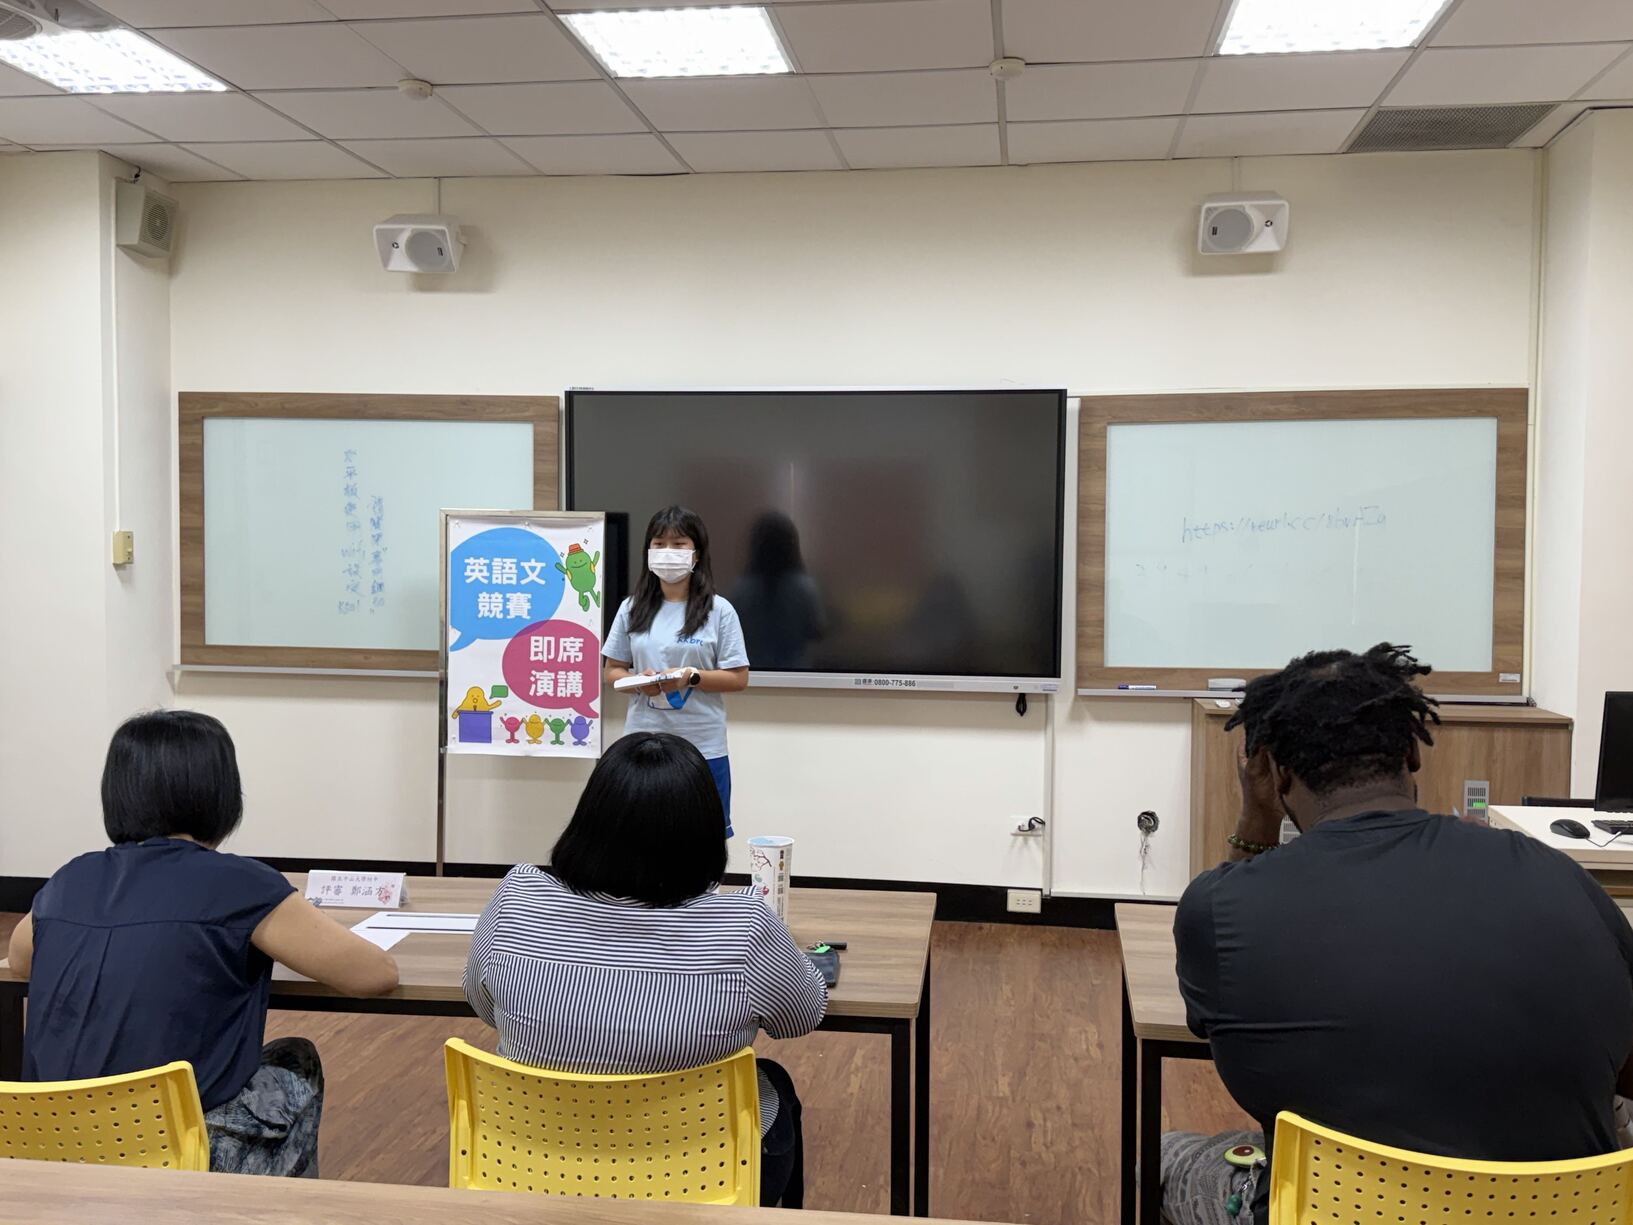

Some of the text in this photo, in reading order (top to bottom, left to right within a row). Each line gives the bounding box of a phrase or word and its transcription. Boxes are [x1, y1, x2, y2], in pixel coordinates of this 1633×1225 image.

[464, 557, 546, 585] 英語文
[477, 592, 532, 620] 競賽
[529, 636, 584, 663] 即席
[529, 670, 583, 698] 演講
